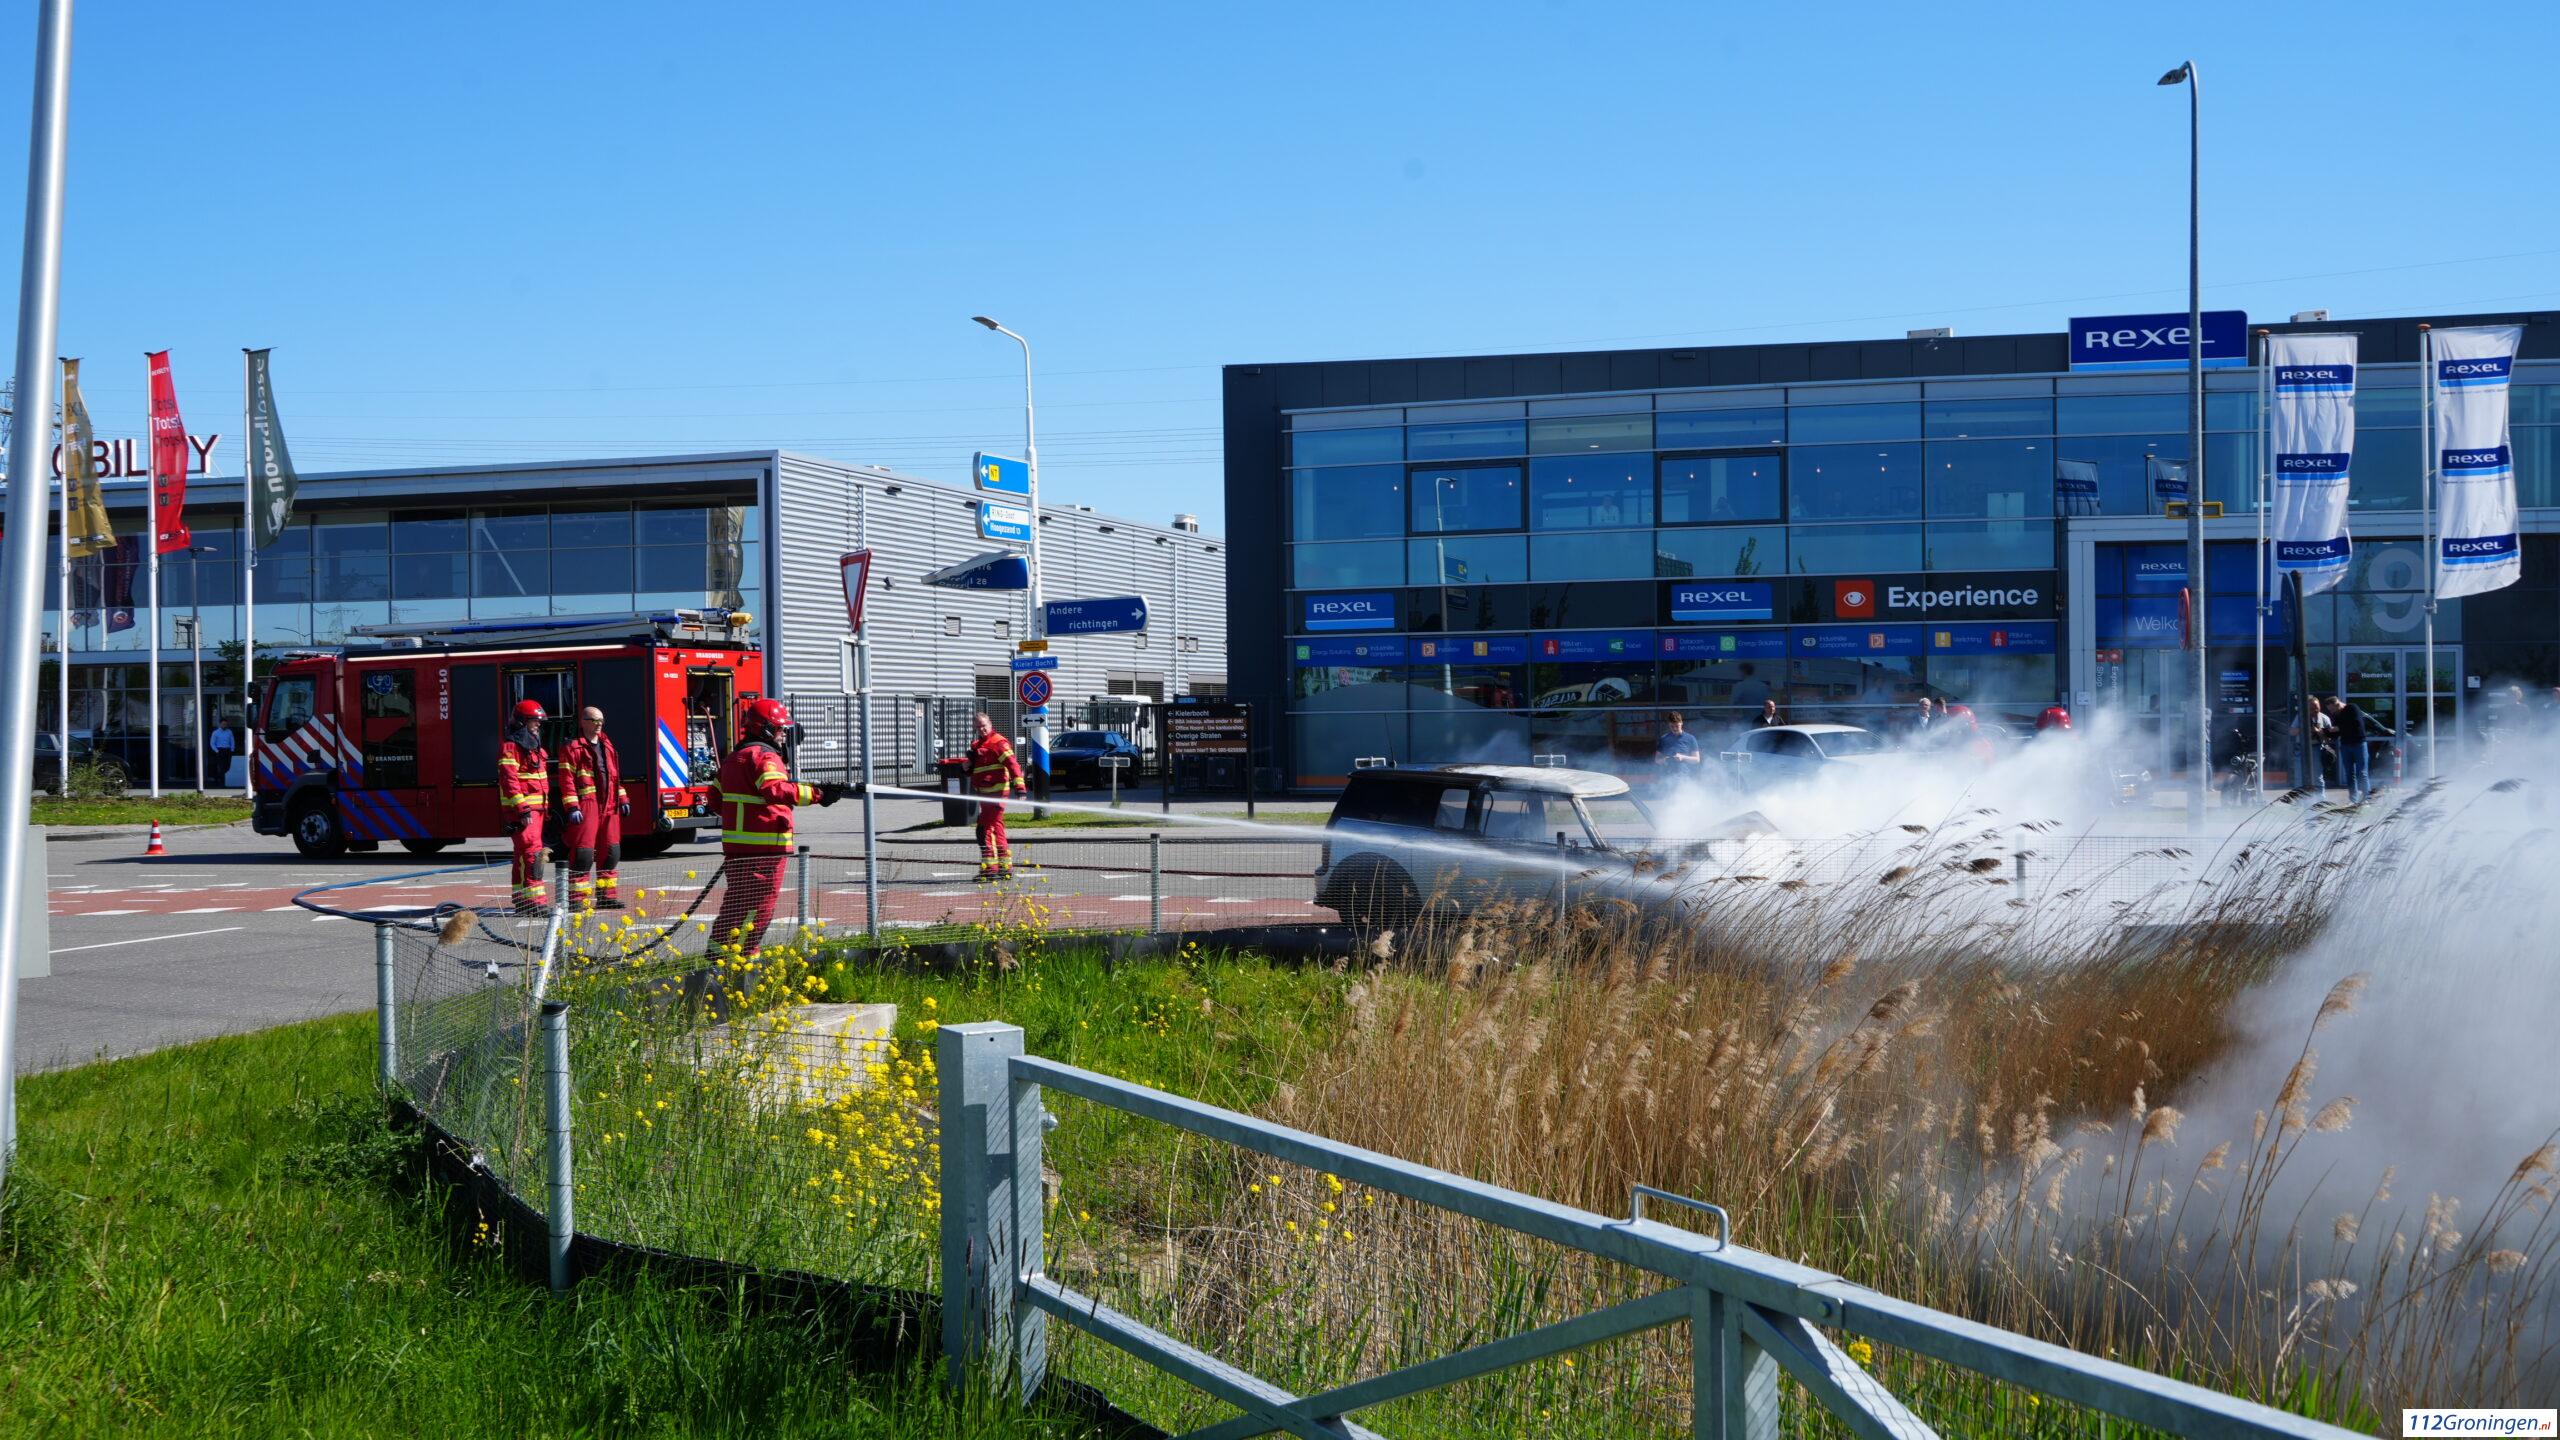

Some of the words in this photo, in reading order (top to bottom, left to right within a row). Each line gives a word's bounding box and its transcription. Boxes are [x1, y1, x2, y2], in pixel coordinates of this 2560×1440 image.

[2368, 548, 2425, 632] 9
[1888, 585, 2038, 611] Experience
[1050, 606, 1082, 615] Andere
[1069, 620, 1118, 630] richtingen
[2135, 616, 2179, 631] Welko
[2362, 672, 2392, 680] Homerun
[439, 669, 449, 720] 01-1832
